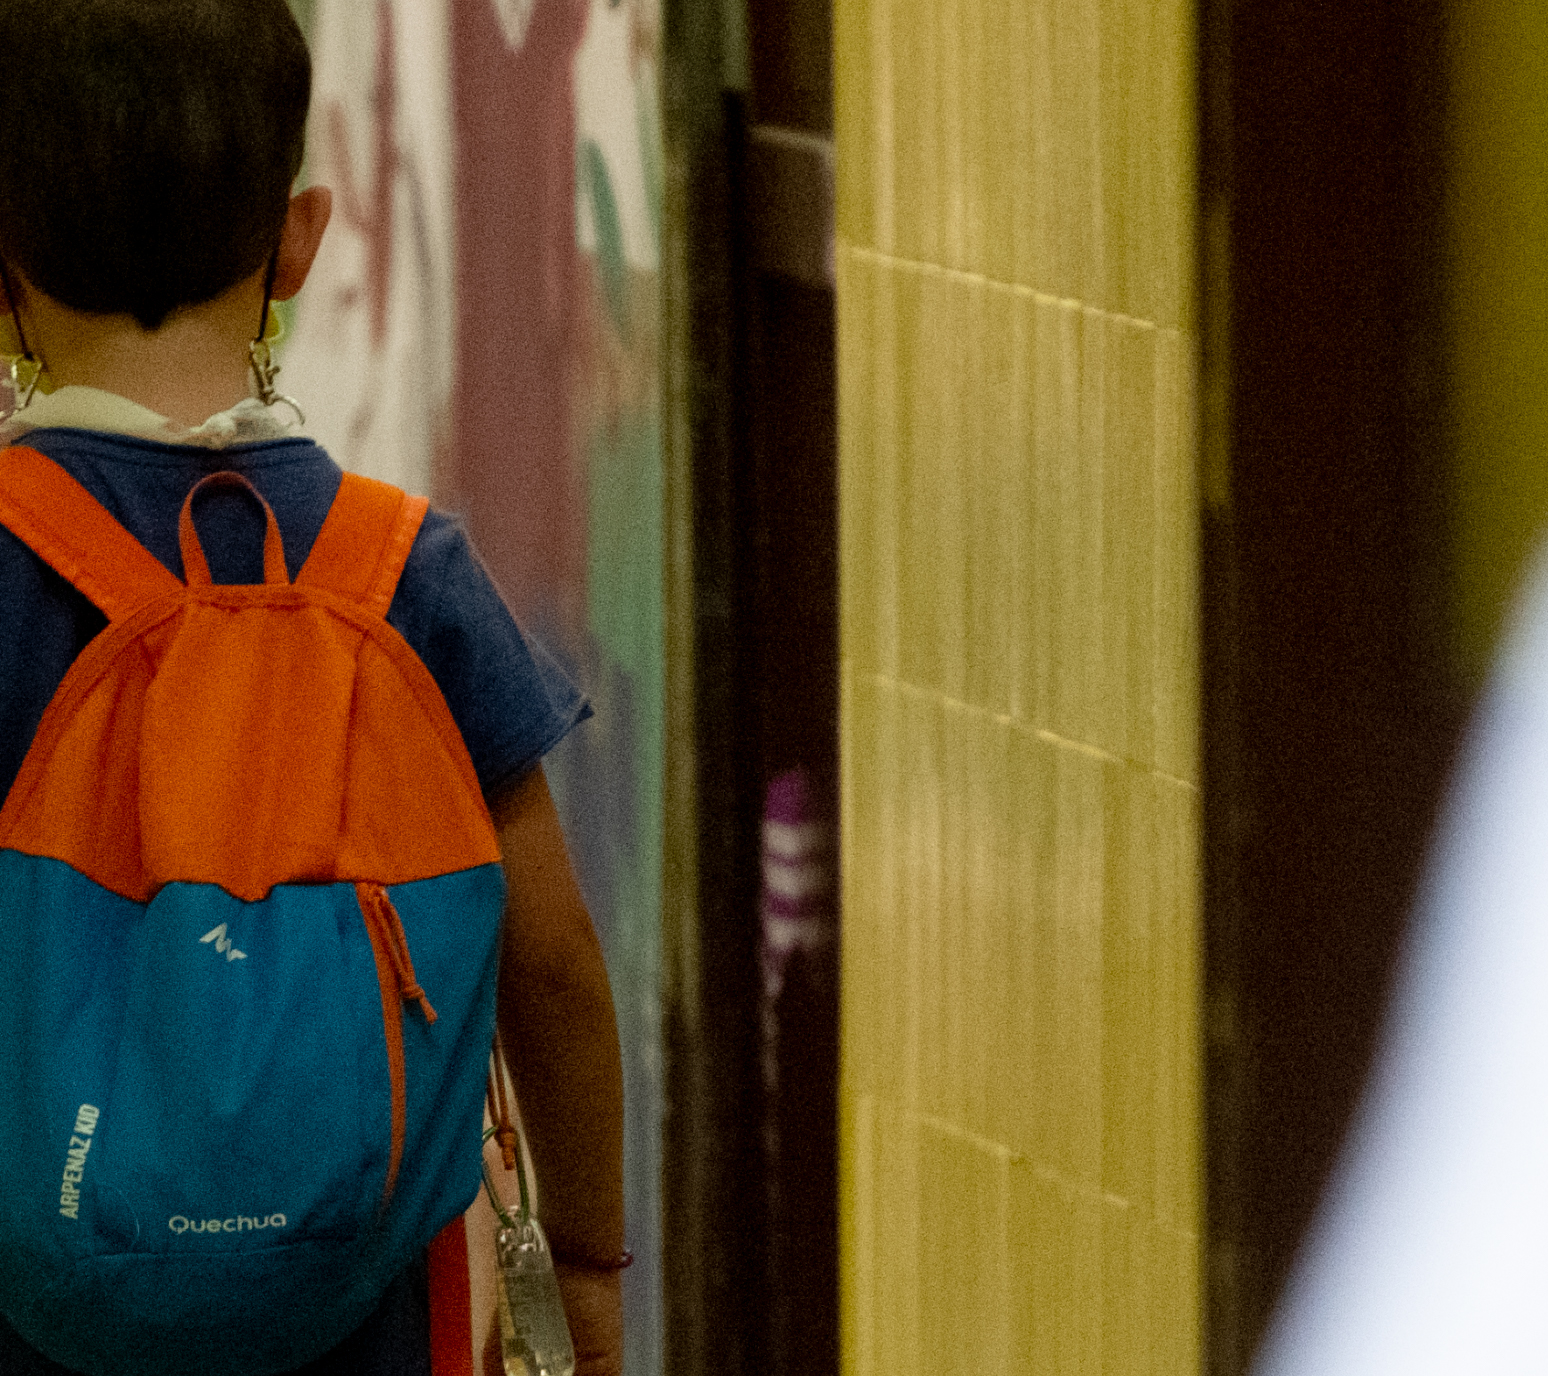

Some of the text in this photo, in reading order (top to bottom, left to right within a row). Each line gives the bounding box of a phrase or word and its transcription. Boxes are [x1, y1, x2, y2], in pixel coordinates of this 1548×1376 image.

[59, 1103, 100, 1220] ARPENAZ KID
[168, 1212, 288, 1235] Quechua
